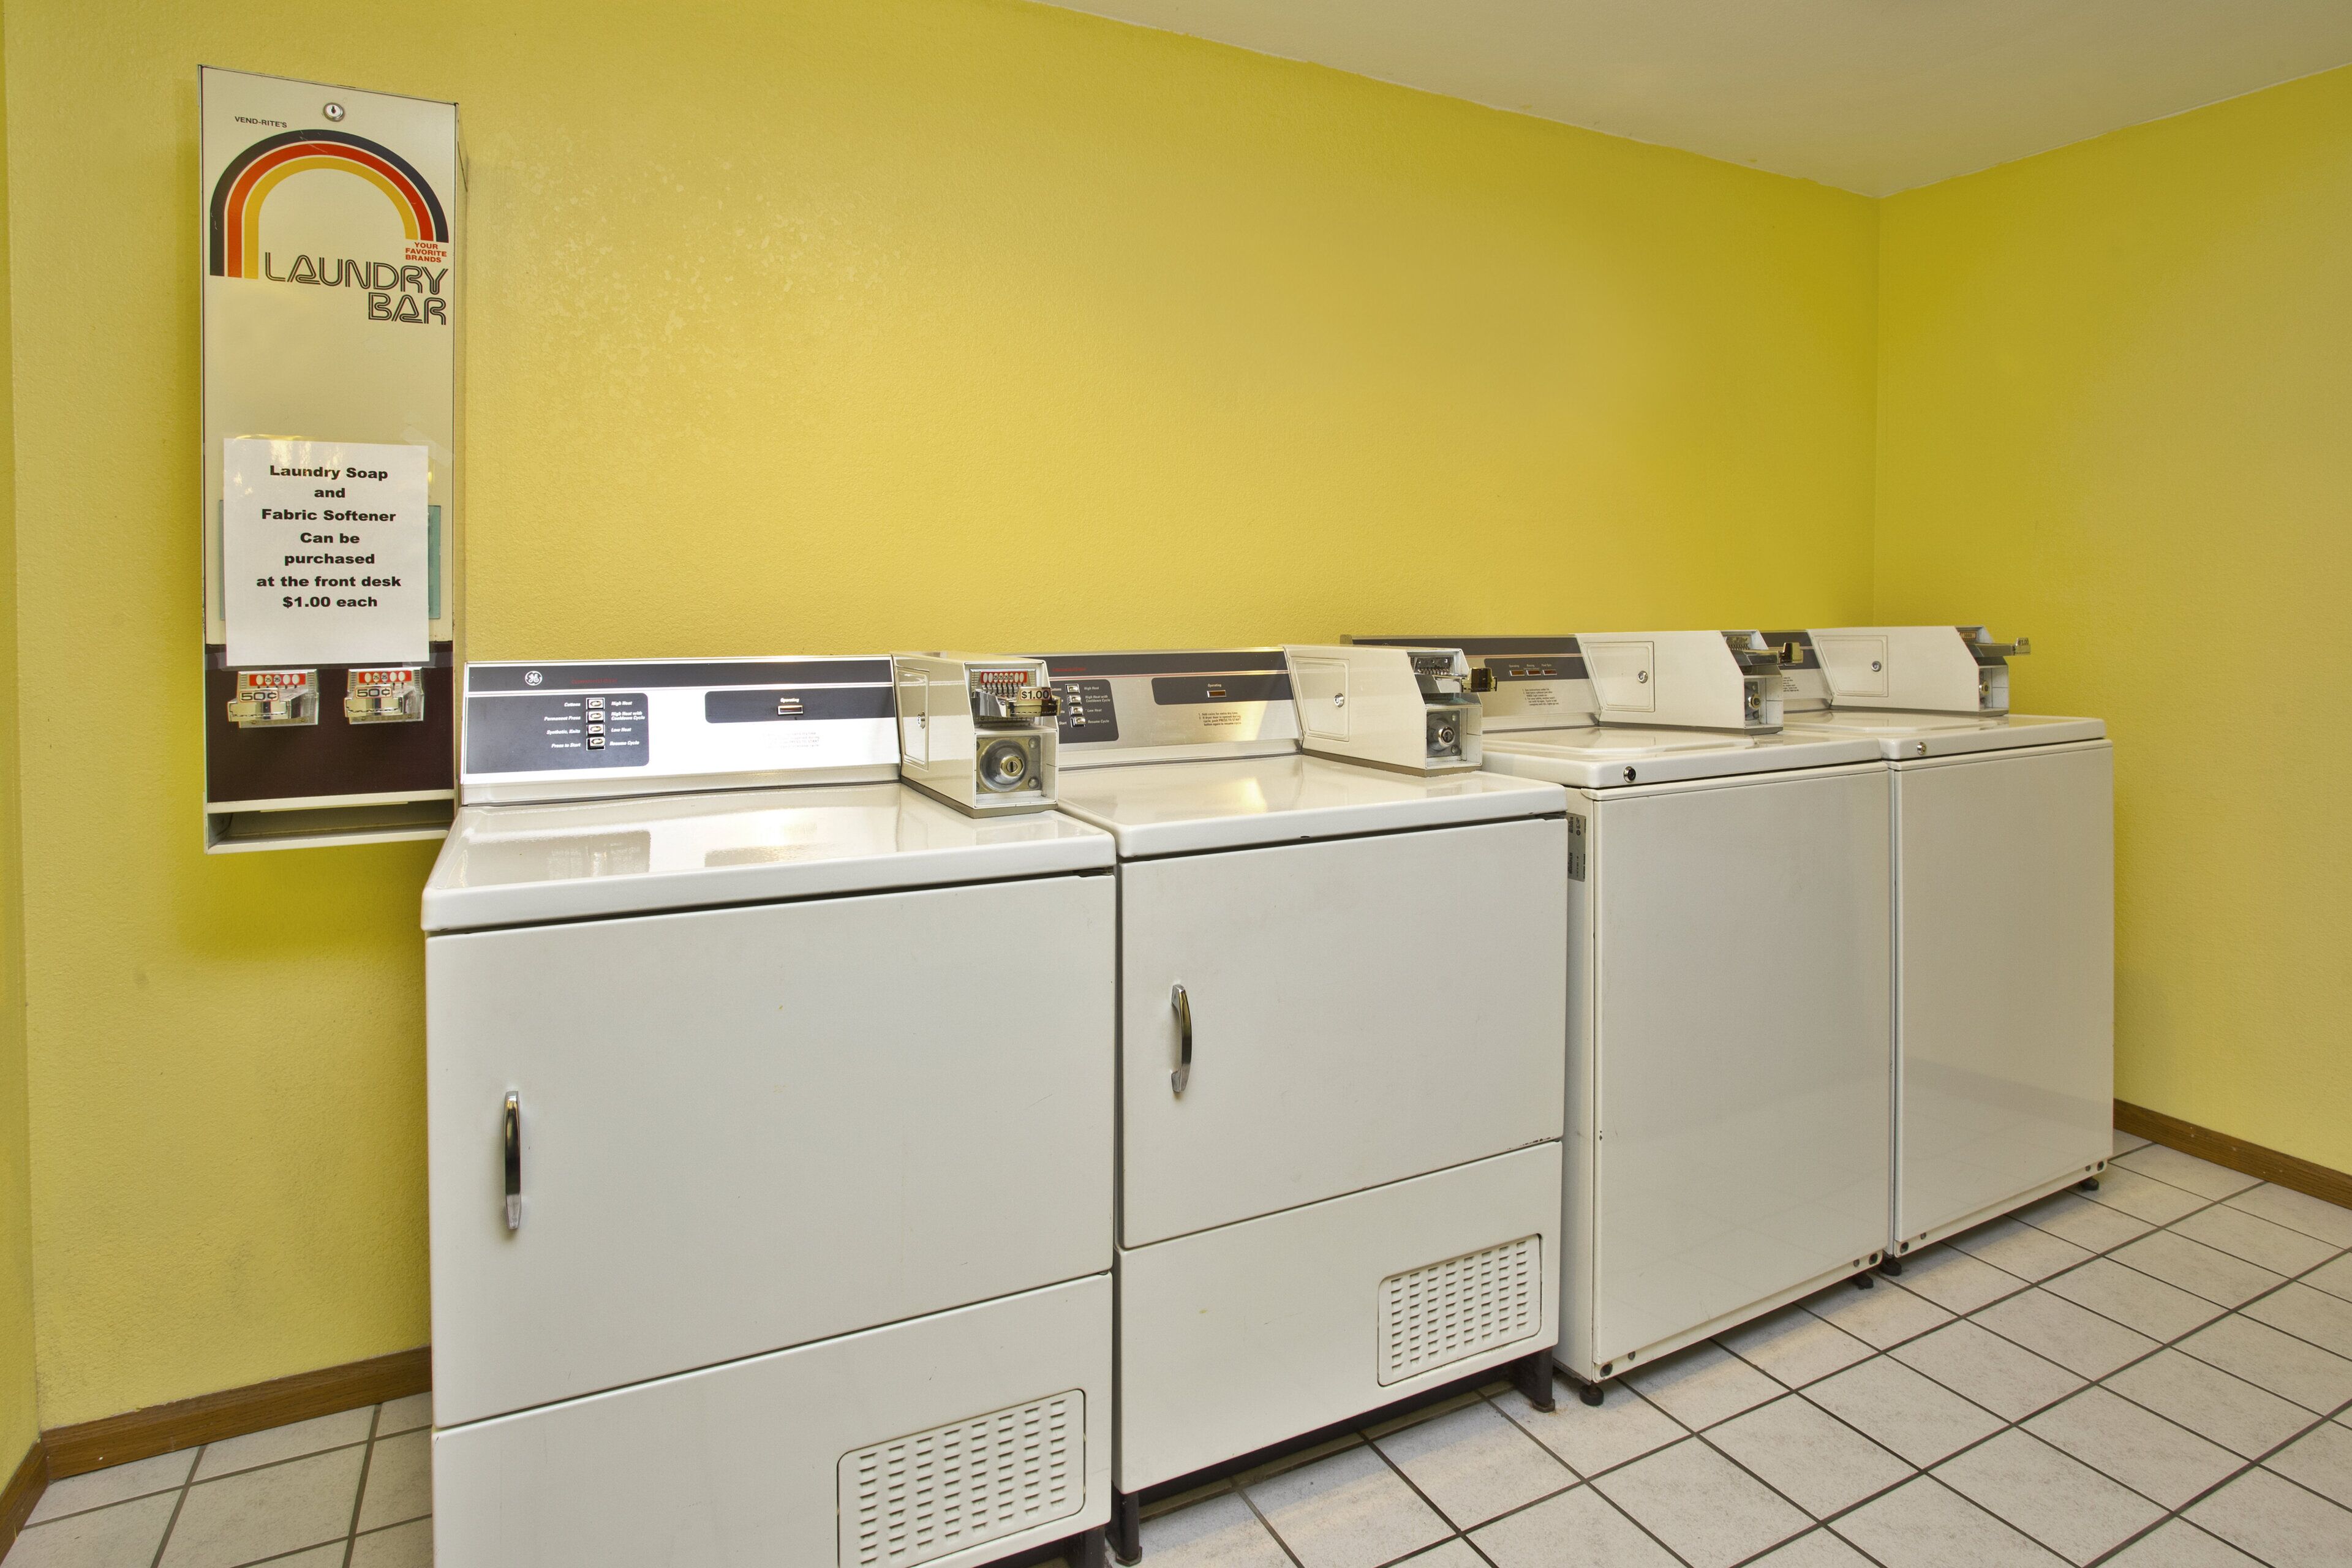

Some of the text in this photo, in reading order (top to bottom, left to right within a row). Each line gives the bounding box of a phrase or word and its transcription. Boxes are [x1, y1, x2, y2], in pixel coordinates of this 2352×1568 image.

[235, 116, 287, 128] VEND-RITE'S
[405, 247, 447, 257] FAVORITE
[405, 254, 442, 263] BRANDS
[265, 252, 448, 295] LAUNDRY
[368, 292, 447, 325] BAR
[270, 466, 388, 481] Laundry Soap
[314, 488, 345, 499] and
[262, 508, 396, 522] Fabric Softener
[300, 532, 360, 544] Can be
[284, 554, 375, 567] purchased
[256, 576, 401, 587] at the front desk
[282, 596, 378, 608] $1.00 each
[241, 691, 277, 701] 50¢
[356, 688, 390, 697] 50¢
[1021, 690, 1049, 699] $1.00
